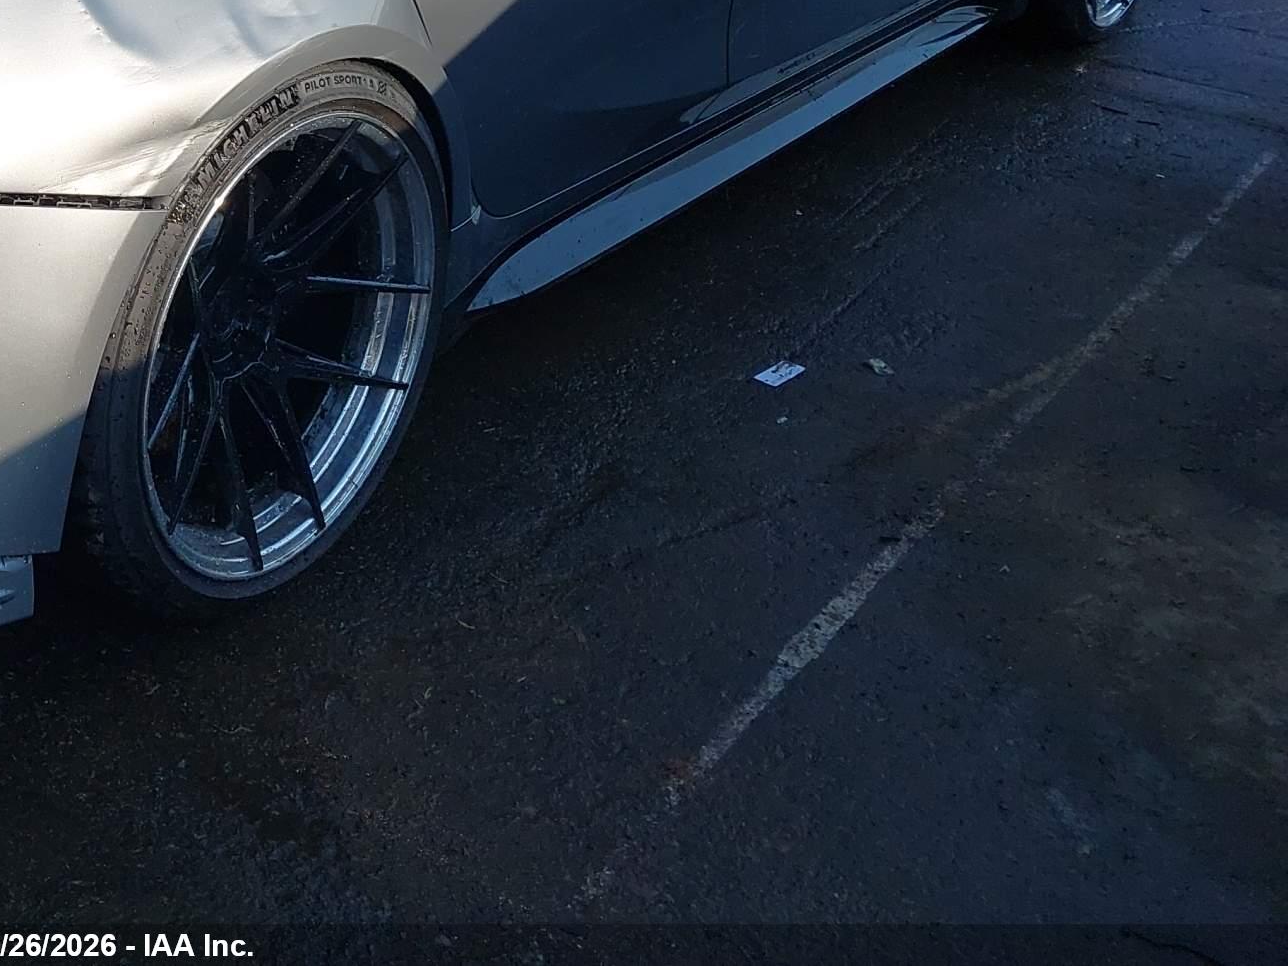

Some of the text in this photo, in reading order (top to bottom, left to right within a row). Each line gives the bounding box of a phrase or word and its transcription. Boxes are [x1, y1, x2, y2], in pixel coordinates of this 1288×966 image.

[304, 76, 331, 94] PILOT
[333, 74, 362, 88] SPORT
[196, 86, 297, 189] MICHELIN
